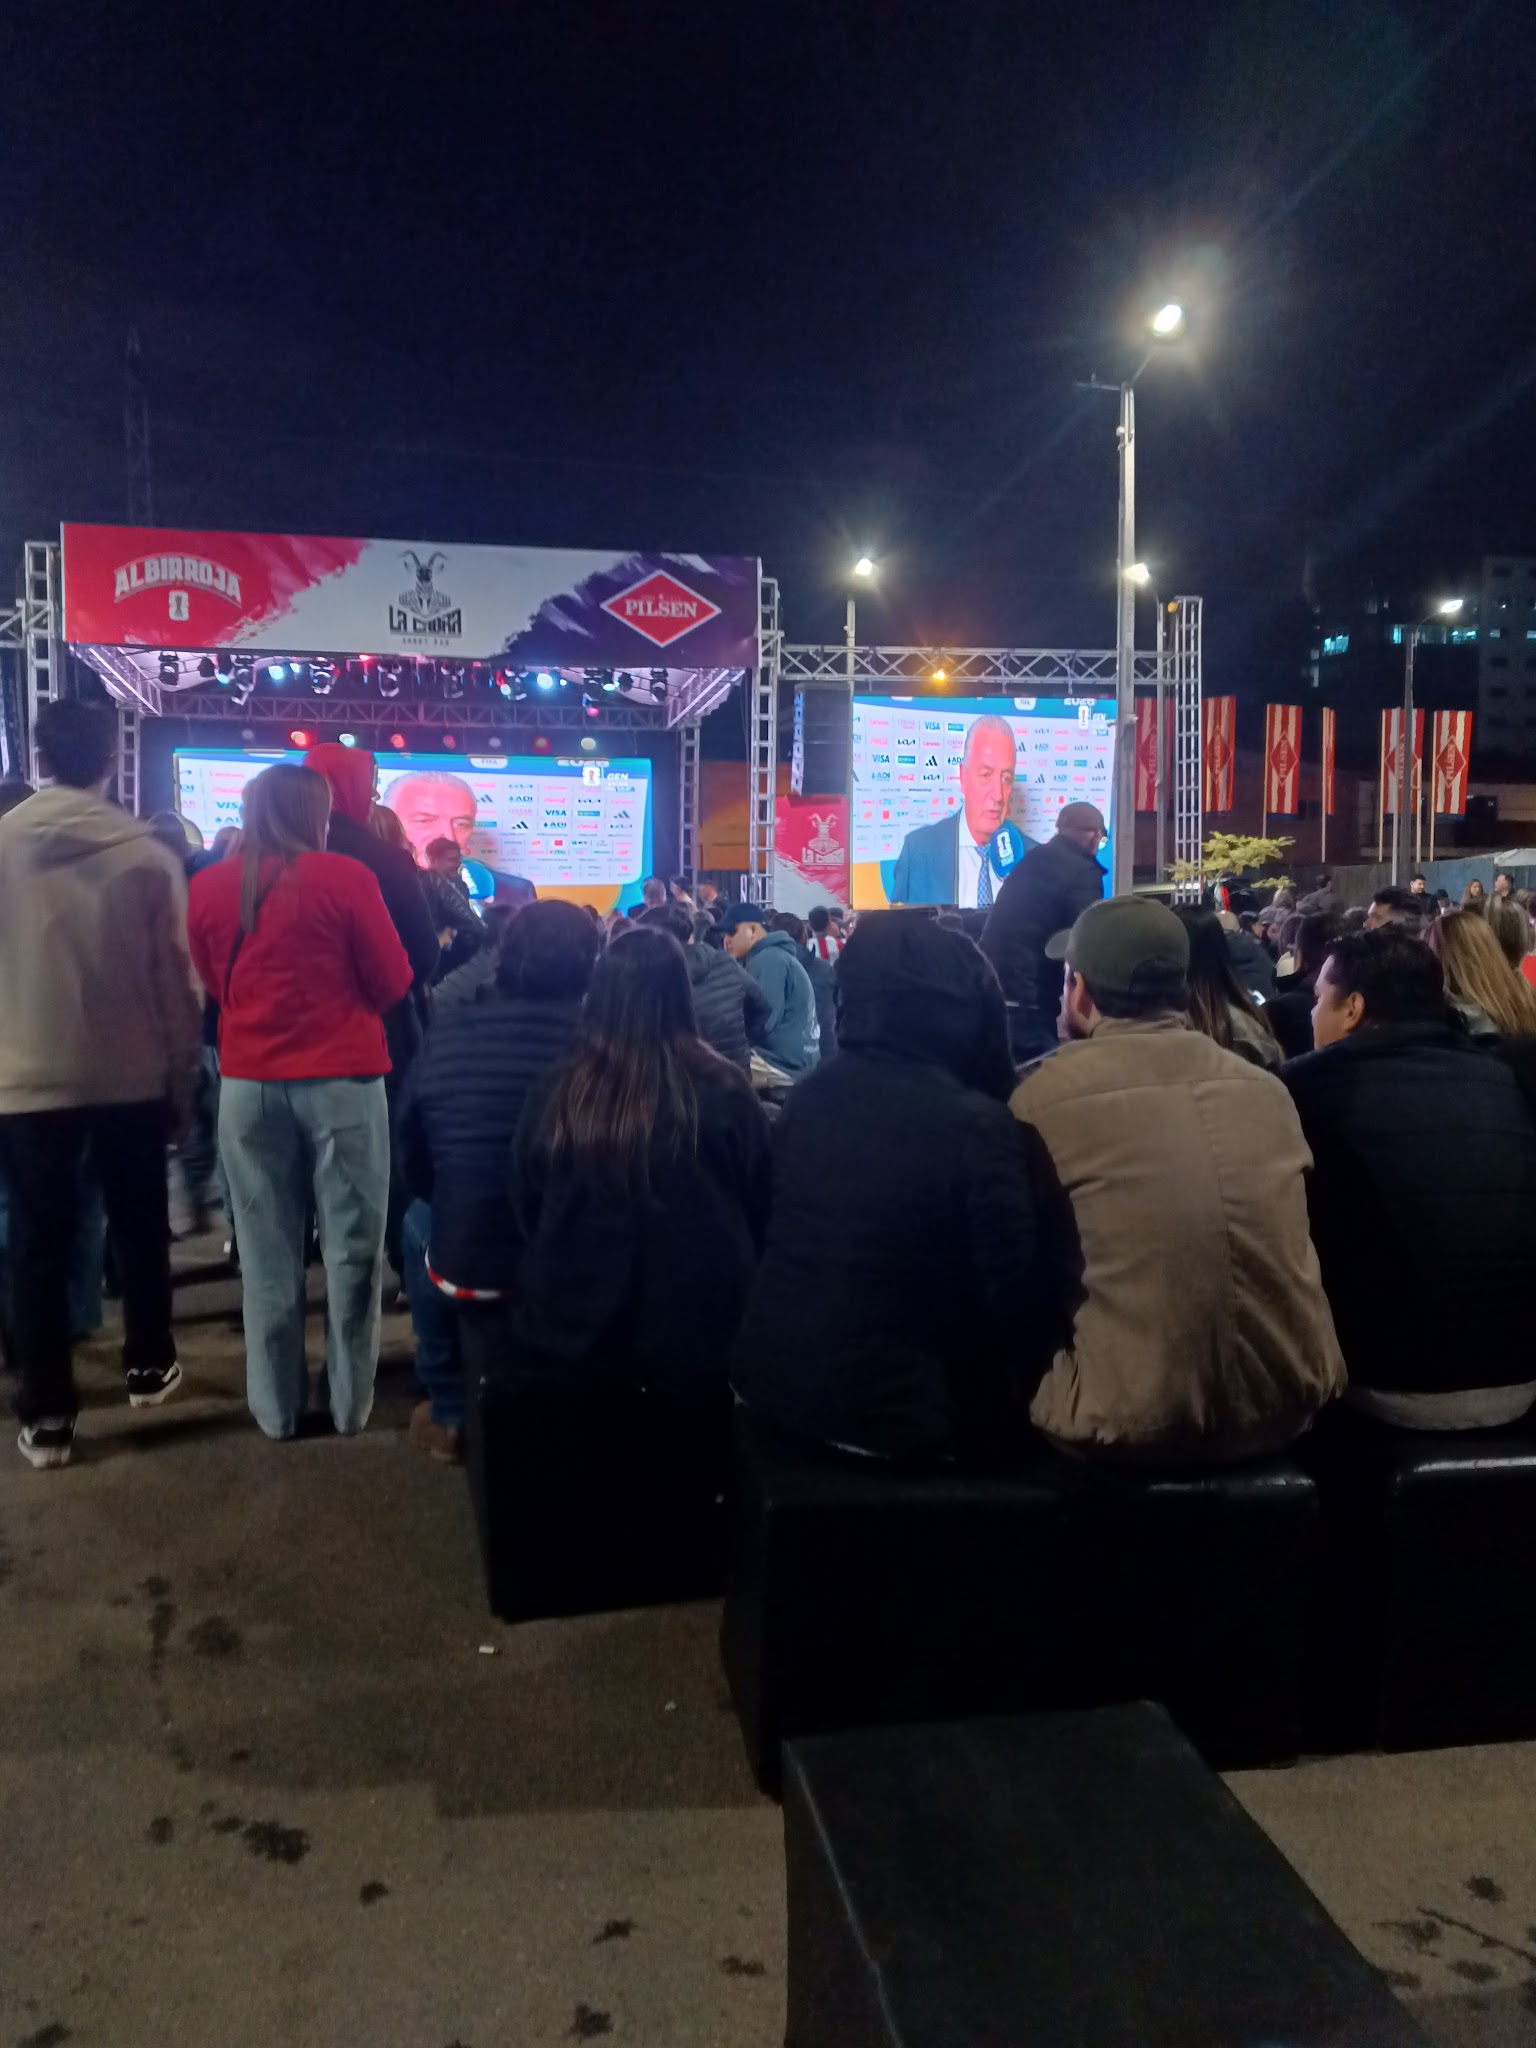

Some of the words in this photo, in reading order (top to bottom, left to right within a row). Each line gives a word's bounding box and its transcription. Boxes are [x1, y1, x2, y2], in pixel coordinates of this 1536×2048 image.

[114, 556, 242, 604] ALBIRROJA
[624, 598, 698, 619] PILSEN
[924, 722, 941, 731] VISA
[872, 754, 890, 764] VISA
[1446, 743, 1456, 780] PILSEN
[607, 772, 629, 781] GEN
